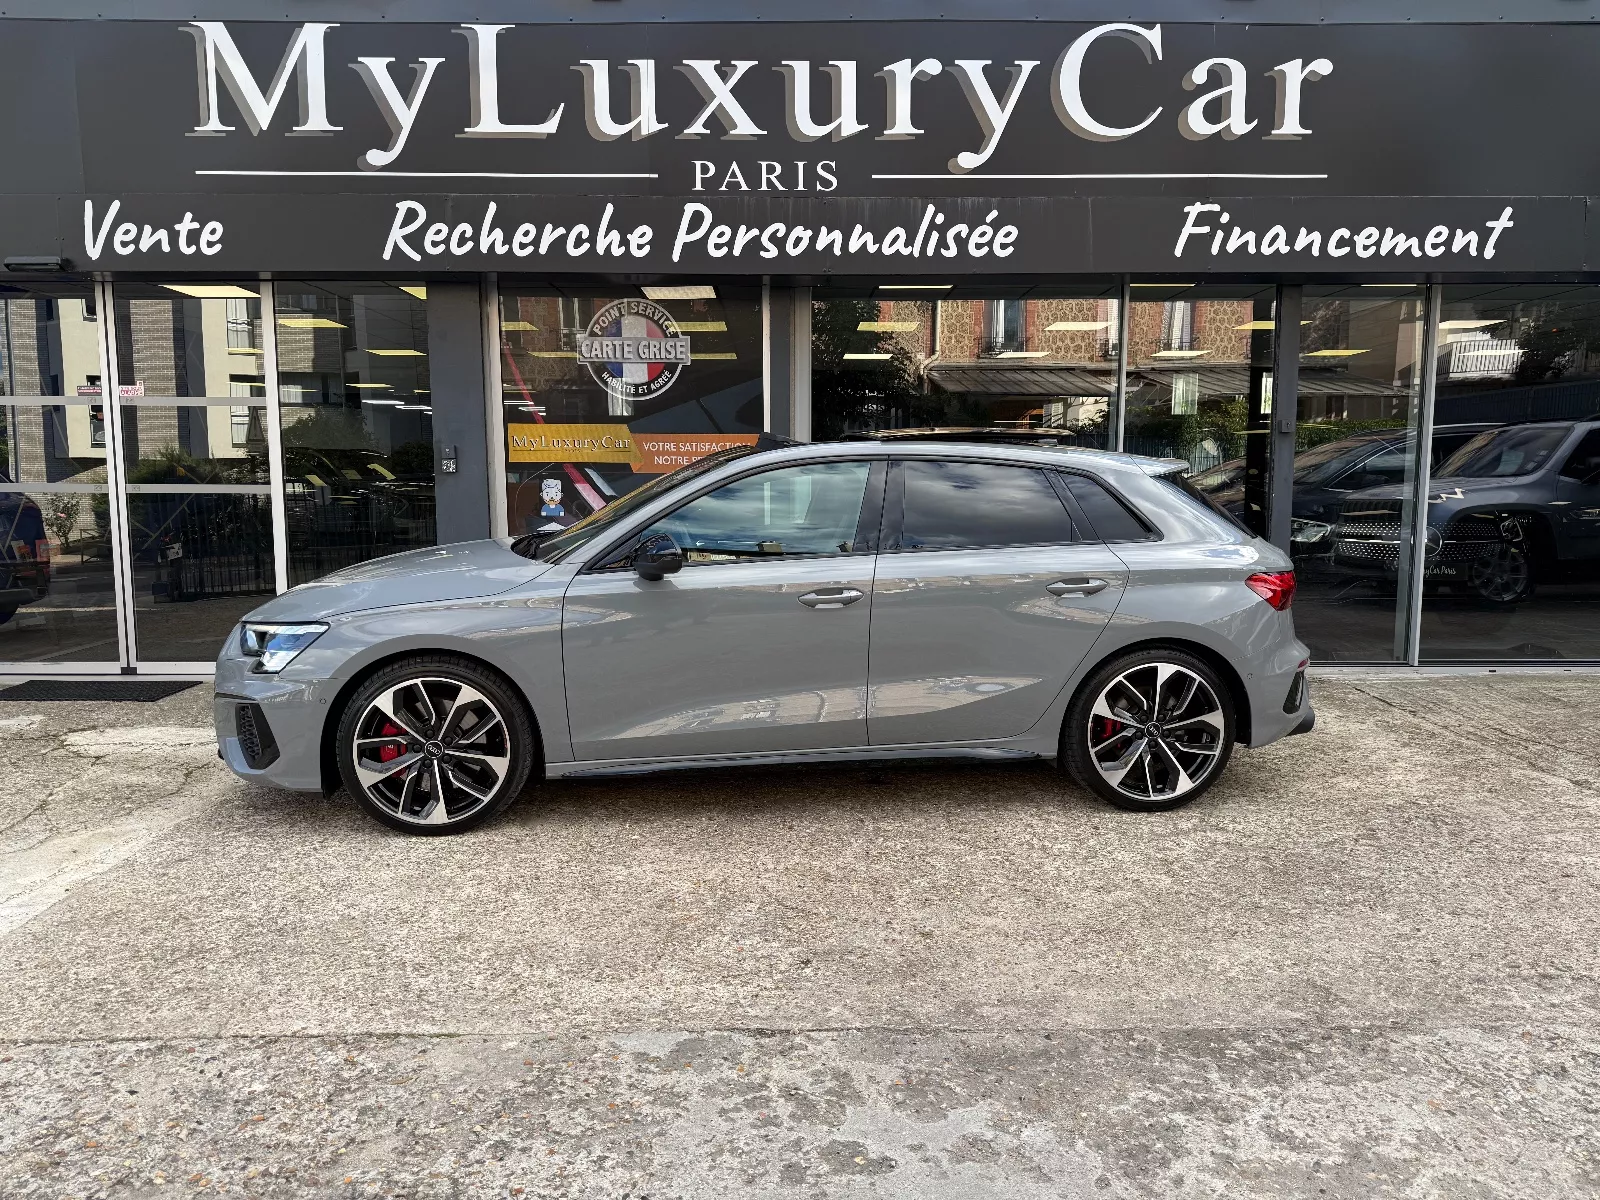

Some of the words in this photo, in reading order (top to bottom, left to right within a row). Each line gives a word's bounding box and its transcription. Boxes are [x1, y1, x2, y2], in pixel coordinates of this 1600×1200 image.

[188, 21, 1335, 169] MyLuxuryCar
[691, 160, 839, 192] PARIS
[83, 199, 224, 261] Vente
[382, 200, 653, 262] Recherche
[671, 202, 1019, 263] Personnalisée
[1174, 201, 1514, 260] Financement
[593, 304, 626, 336] POINT
[631, 302, 677, 337] SERVICE
[581, 340, 633, 359] CARTE
[638, 340, 686, 360] GRISE
[638, 386, 648, 394] ET
[511, 435, 631, 451] MyLuxuryCar
[643, 442, 677, 452] VOTRE
[654, 455, 689, 465] NOTRE
